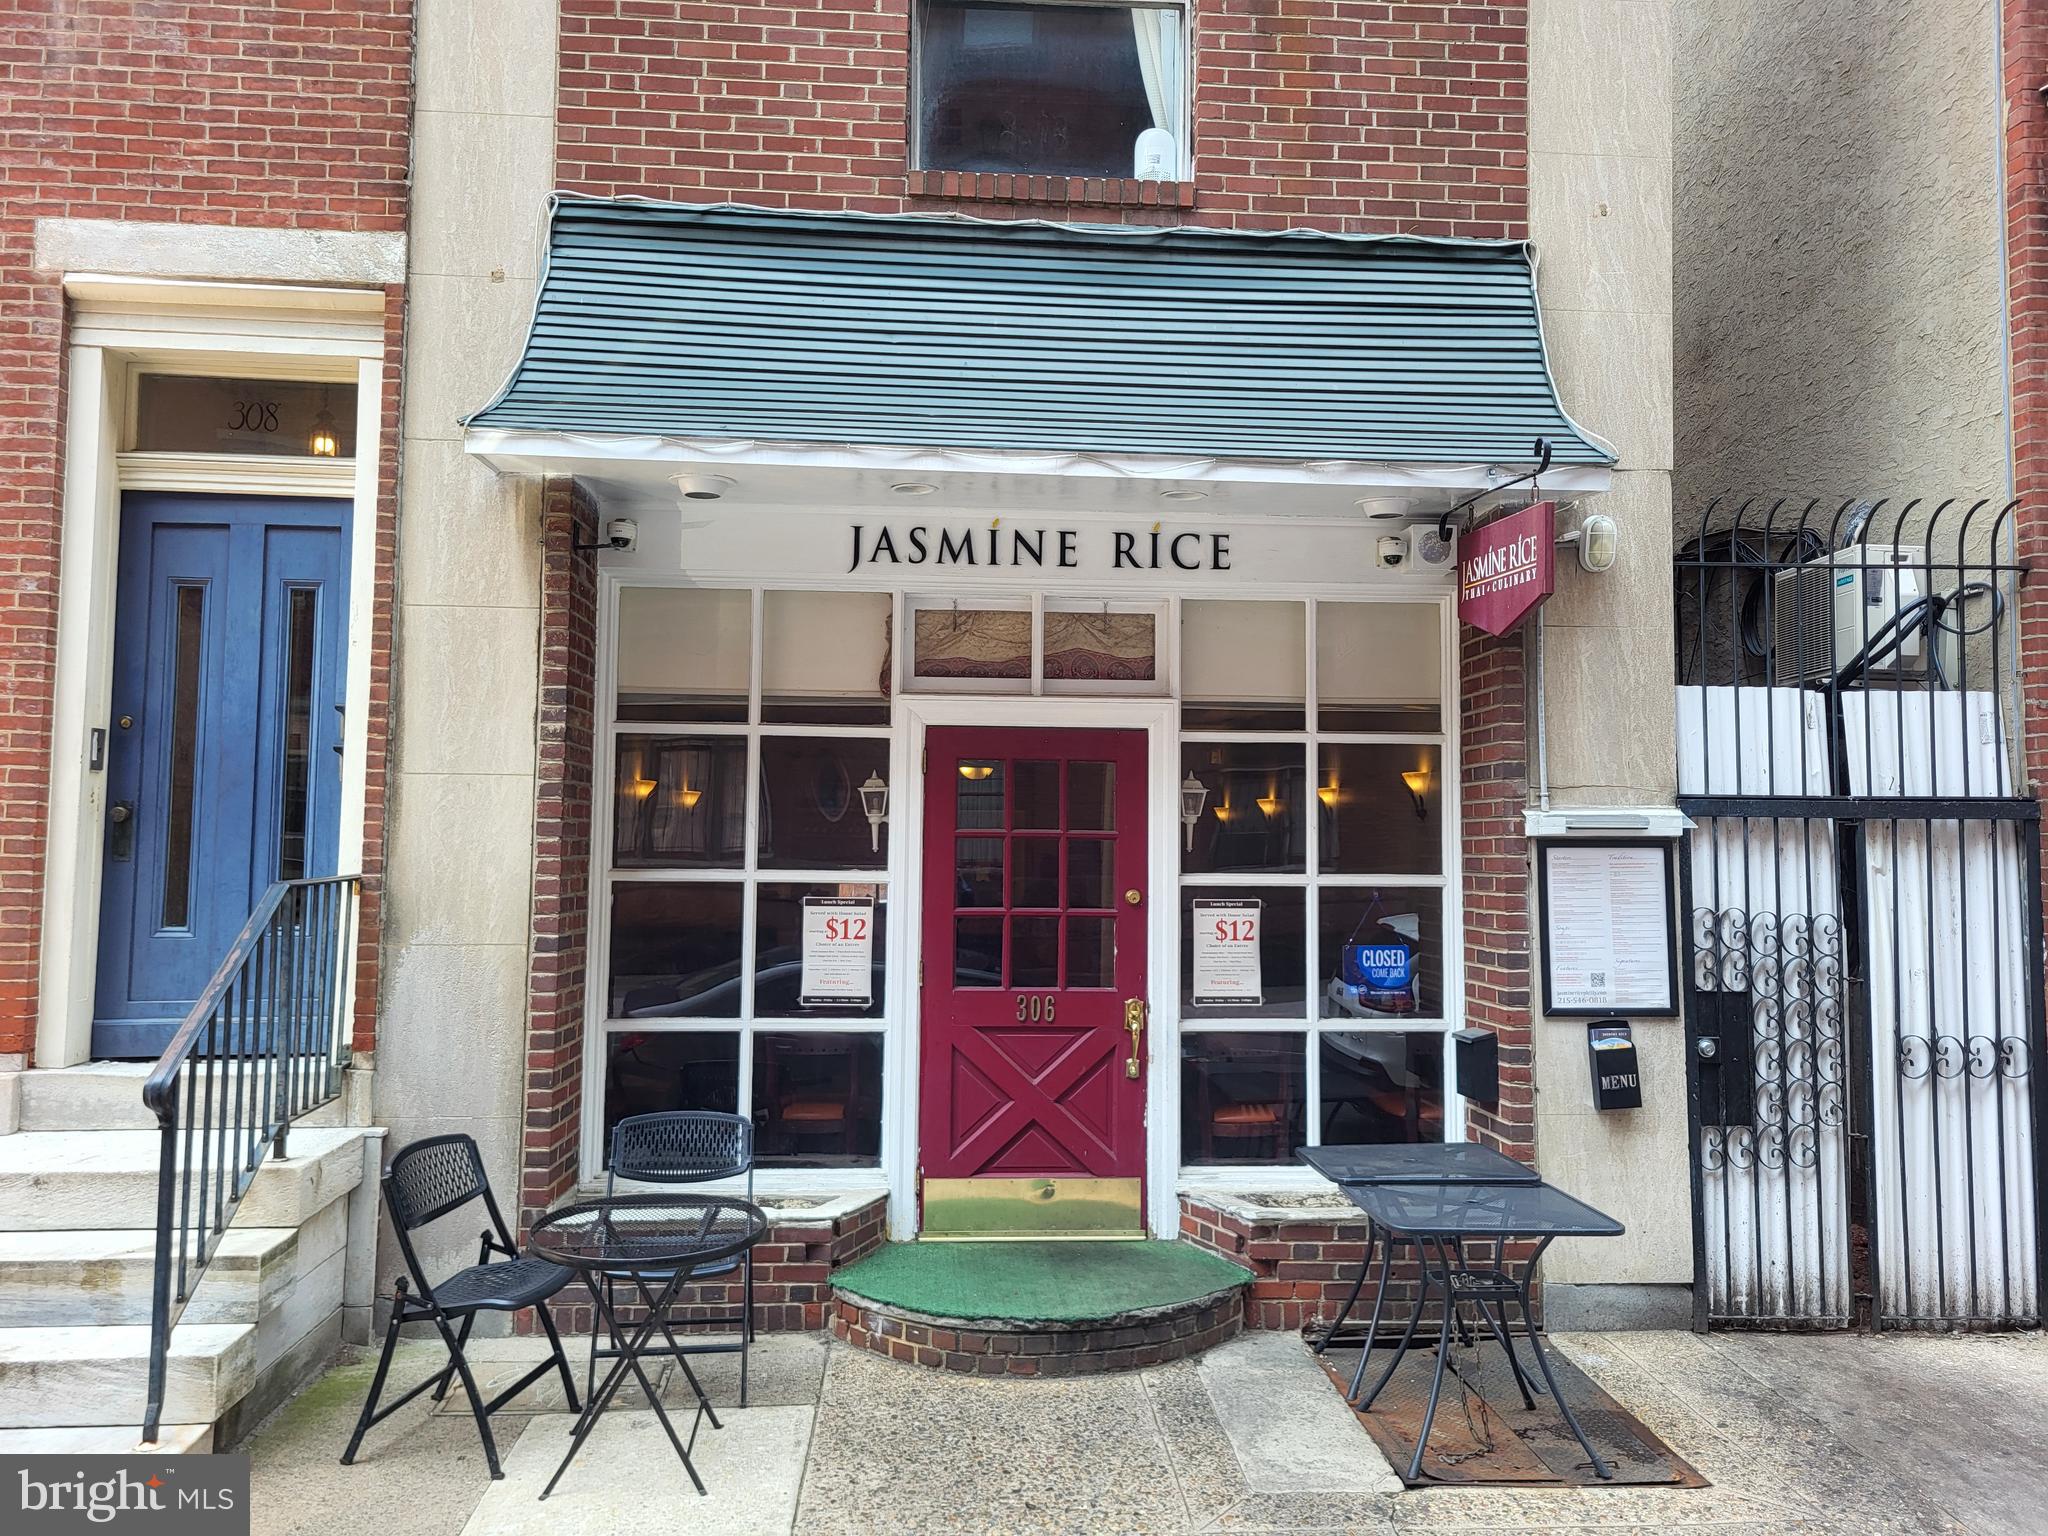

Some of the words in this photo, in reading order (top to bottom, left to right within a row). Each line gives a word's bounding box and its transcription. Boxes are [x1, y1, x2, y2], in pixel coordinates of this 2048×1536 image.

[227, 401, 281, 432] 308
[1465, 587, 1485, 601] THAI
[1492, 568, 1537, 592] CULINARY
[826, 916, 867, 942] $12
[1215, 917, 1255, 943] $12
[1363, 949, 1405, 967] CLOSED
[1372, 968, 1388, 978] COME
[1389, 968, 1406, 978] BACK
[1016, 994, 1055, 1022] 306
[1601, 1073, 1637, 1090] MENU
